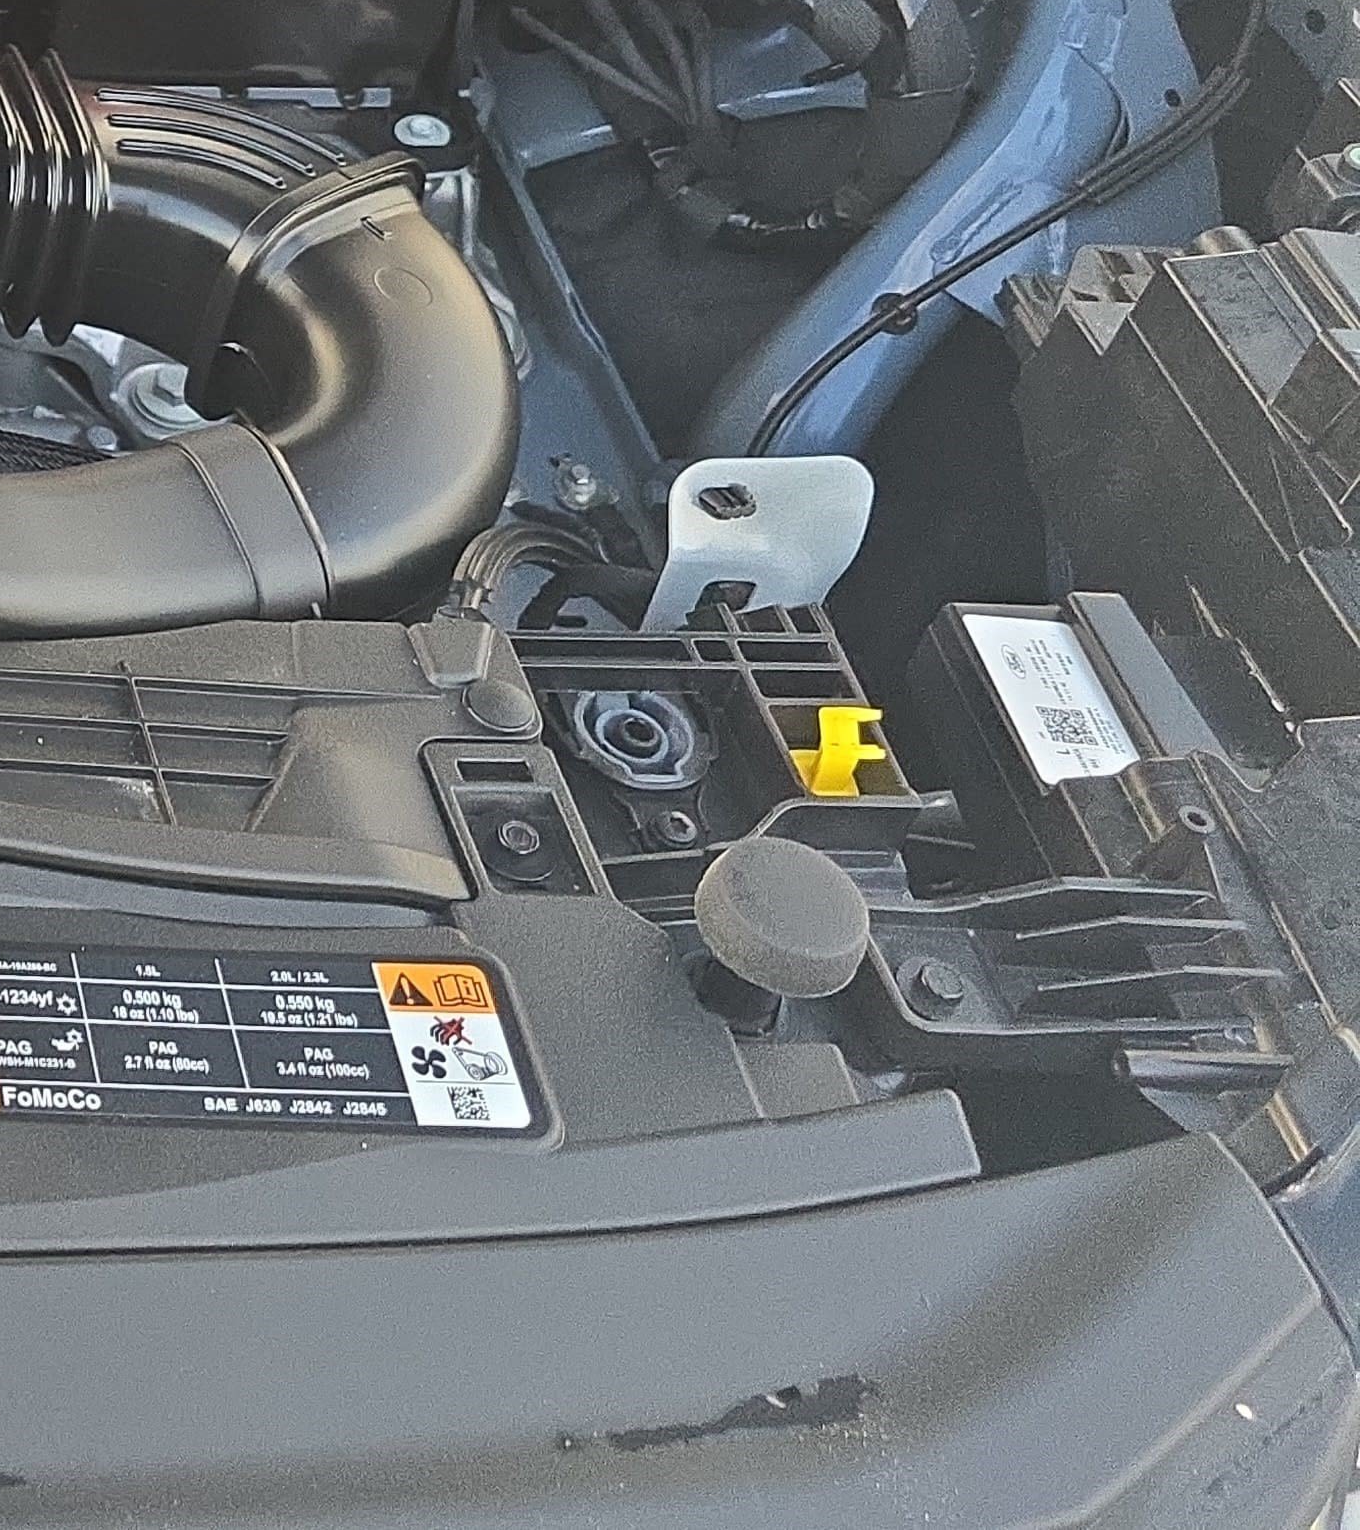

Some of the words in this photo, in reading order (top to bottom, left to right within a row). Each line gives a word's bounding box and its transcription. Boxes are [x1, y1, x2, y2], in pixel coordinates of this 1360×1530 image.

[270, 971, 296, 983] 2.0L
[122, 990, 161, 1005] 0.500
[163, 991, 182, 1009] kg
[275, 996, 313, 1011] 0.550
[315, 997, 335, 1013] kg
[112, 1005, 127, 1019] 18
[129, 1009, 145, 1019] oz
[146, 1007, 175, 1022] (1.10
[177, 1008, 199, 1023] lbs)
[288, 1014, 304, 1025] oz
[305, 1012, 333, 1027] (1.21
[334, 1013, 358, 1028] lbs)
[148, 1041, 178, 1055] PAG
[304, 1047, 334, 1061] PAG
[124, 1055, 142, 1070] 2.7
[144, 1056, 154, 1070] fl
[156, 1058, 171, 1070] oz
[276, 1062, 297, 1075] 3.4
[297, 1062, 308, 1076] fl
[310, 1065, 325, 1076] oz
[326, 1063, 370, 1080] (100cc)
[1, 1086, 102, 1111] FoMoCo
[203, 1097, 239, 1112] SAE
[246, 1098, 282, 1113] J639
[289, 1100, 333, 1114] J2842
[342, 1102, 388, 1116] J2845
